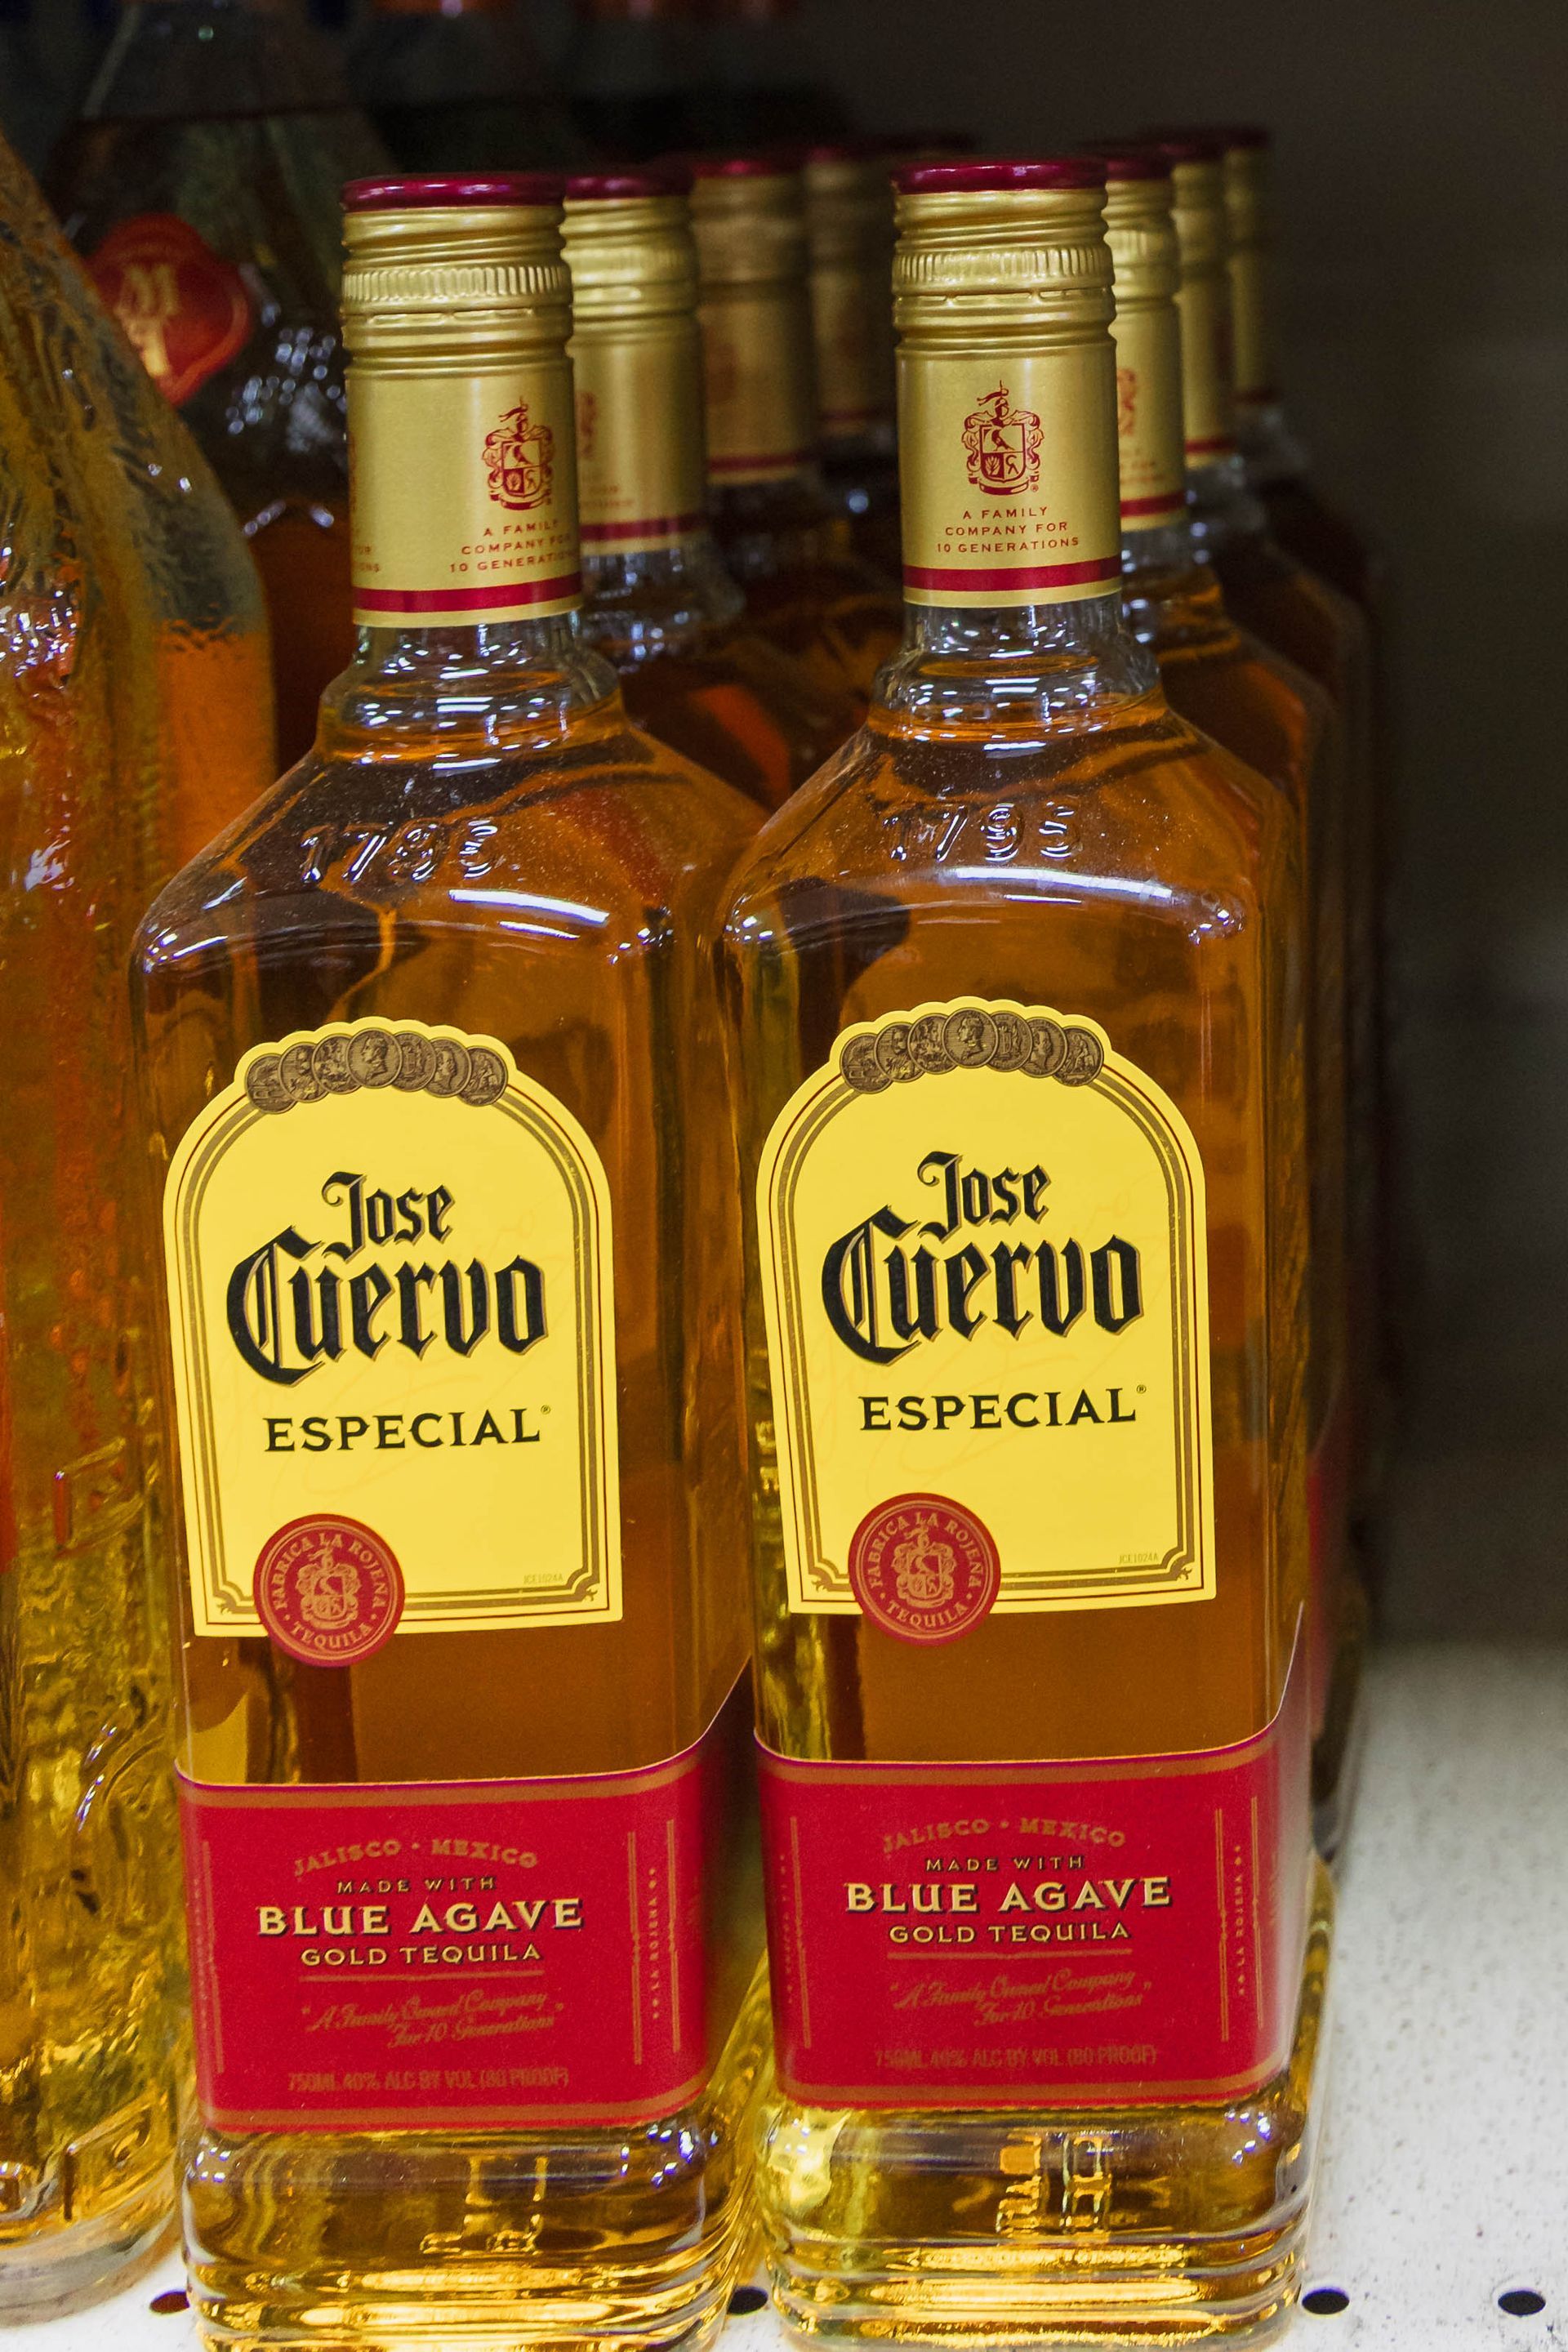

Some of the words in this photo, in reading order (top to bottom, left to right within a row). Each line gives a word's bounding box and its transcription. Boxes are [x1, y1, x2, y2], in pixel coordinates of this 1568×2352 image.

[963, 510, 972, 519] A
[982, 506, 1048, 519] FAMILY
[483, 528, 492, 537] A
[945, 525, 1027, 536] COMPANY
[1036, 522, 1068, 532] FOR
[461, 539, 544, 555] COMPANY
[938, 543, 951, 553] 10
[958, 537, 1079, 553] GENERATIONS
[450, 563, 469, 572] 10
[917, 1150, 1052, 1244] Jose
[321, 1171, 455, 1263] Jose
[822, 1205, 1145, 1366] Cuervo
[226, 1225, 549, 1388] Cuervo
[858, 1388, 1137, 1431] ESPECIAL
[262, 1409, 541, 1453] ESPECIAL
[915, 1512, 939, 1527] LA
[318, 1532, 343, 1548] LA
[886, 1600, 969, 1629] TEQUILA
[291, 1621, 374, 1650] TEQUILA
[882, 1818, 991, 1854] JALISCO
[1020, 1818, 1126, 1848] MEXICO
[294, 1839, 402, 1877] JALISCO
[431, 1838, 538, 1869] MEXICO
[925, 1857, 999, 1872] MADE
[1013, 1855, 1084, 1870] WITH
[336, 1879, 410, 1895] MADE
[424, 1877, 497, 1892] WITH
[844, 1882, 978, 1913] BLUE
[997, 1875, 1171, 1913] AGAVE
[256, 1904, 391, 1936] BLUE
[409, 1896, 584, 1936] AGAVE
[889, 1925, 977, 1944] GOLD
[987, 1921, 1131, 1944] TEQUILA
[301, 1947, 389, 1967] GOLD
[399, 1943, 542, 1965] TEQUILA
